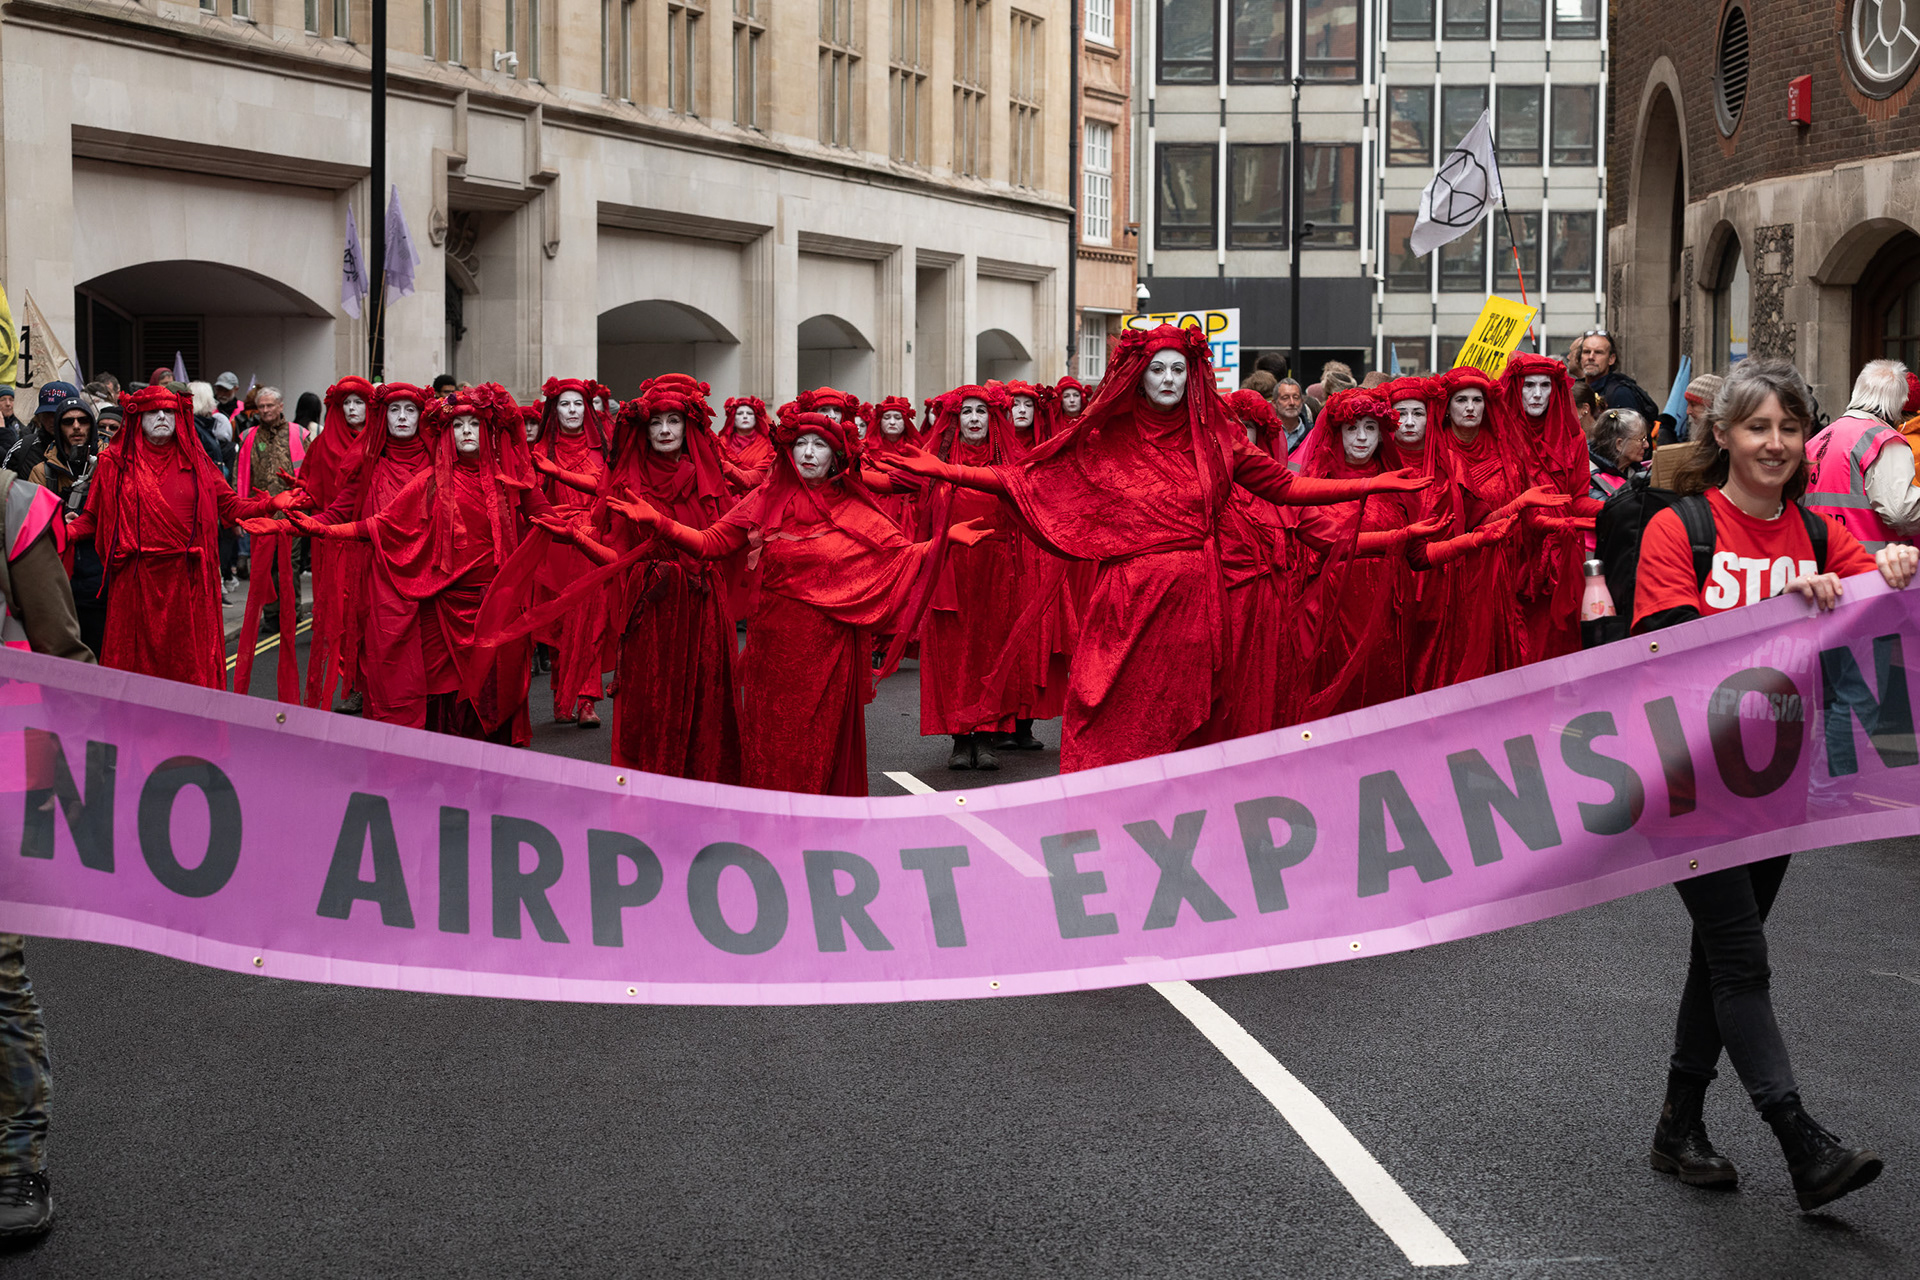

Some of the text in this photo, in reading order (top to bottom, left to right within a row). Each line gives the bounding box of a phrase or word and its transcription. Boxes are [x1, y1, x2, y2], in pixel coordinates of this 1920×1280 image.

[1478, 313, 1517, 348] TEACH
[1460, 343, 1504, 379] CLIMATE
[20, 633, 1919, 955] NO AIRPORT EXPANSION
